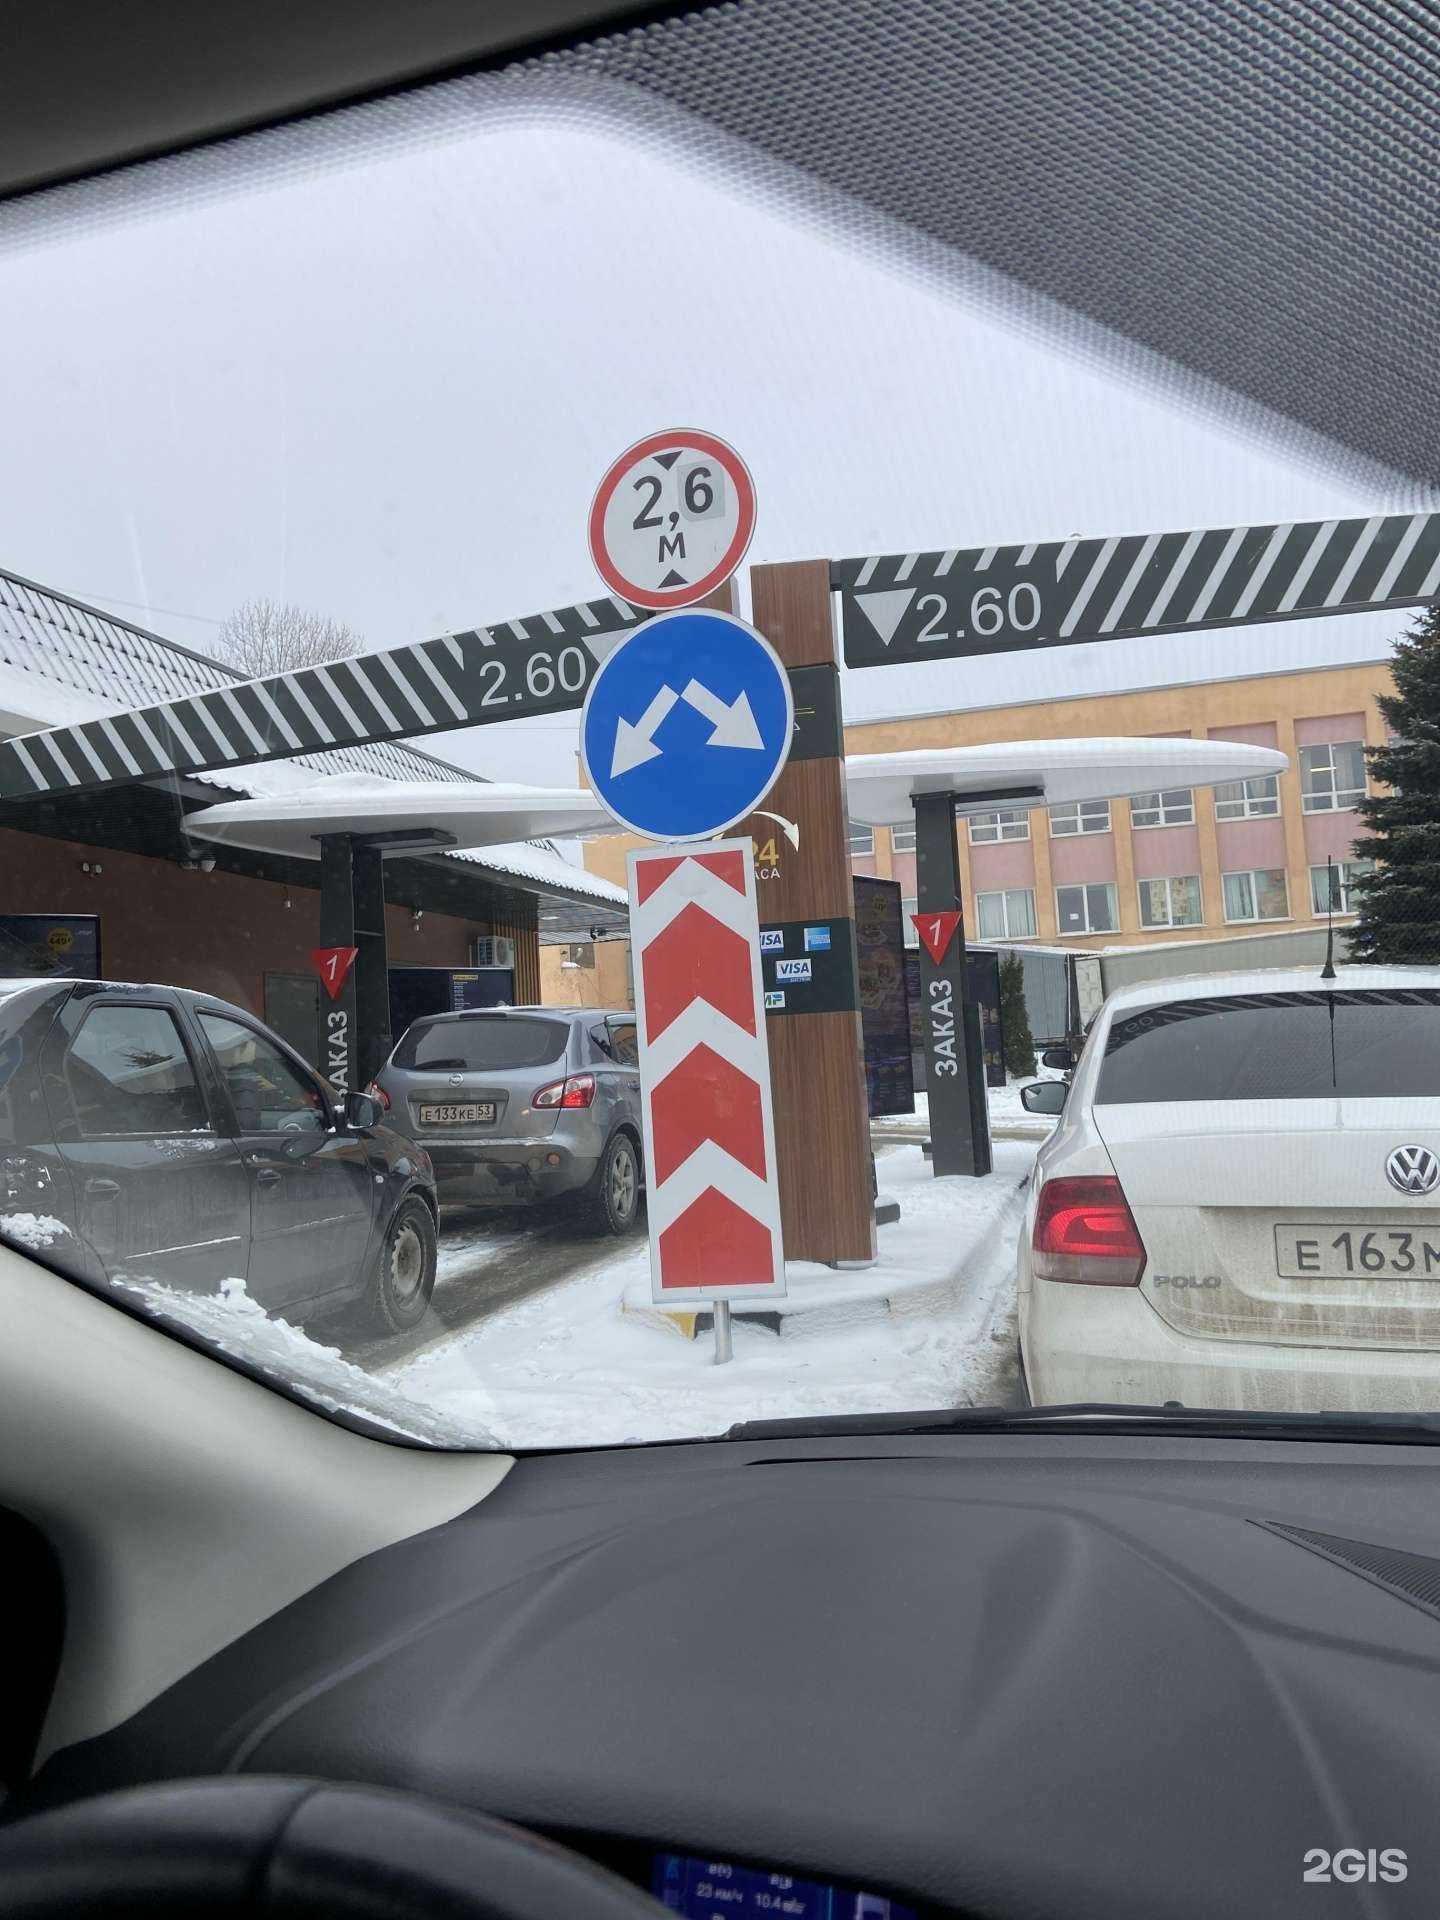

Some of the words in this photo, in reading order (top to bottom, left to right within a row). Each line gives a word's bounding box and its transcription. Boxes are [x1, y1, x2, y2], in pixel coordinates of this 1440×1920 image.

[632, 467, 714, 531] 2,6
[916, 582, 1042, 643] 2.60
[479, 646, 586, 706] 2.60
[760, 933, 782, 946] ISA
[930, 919, 942, 946] 1
[326, 954, 338, 981] 1
[780, 962, 810, 975] VISA
[929, 978, 959, 1078] ЗАКАЗ
[478, 1105, 491, 1116] 53
[1153, 1274, 1222, 1289] POLO
